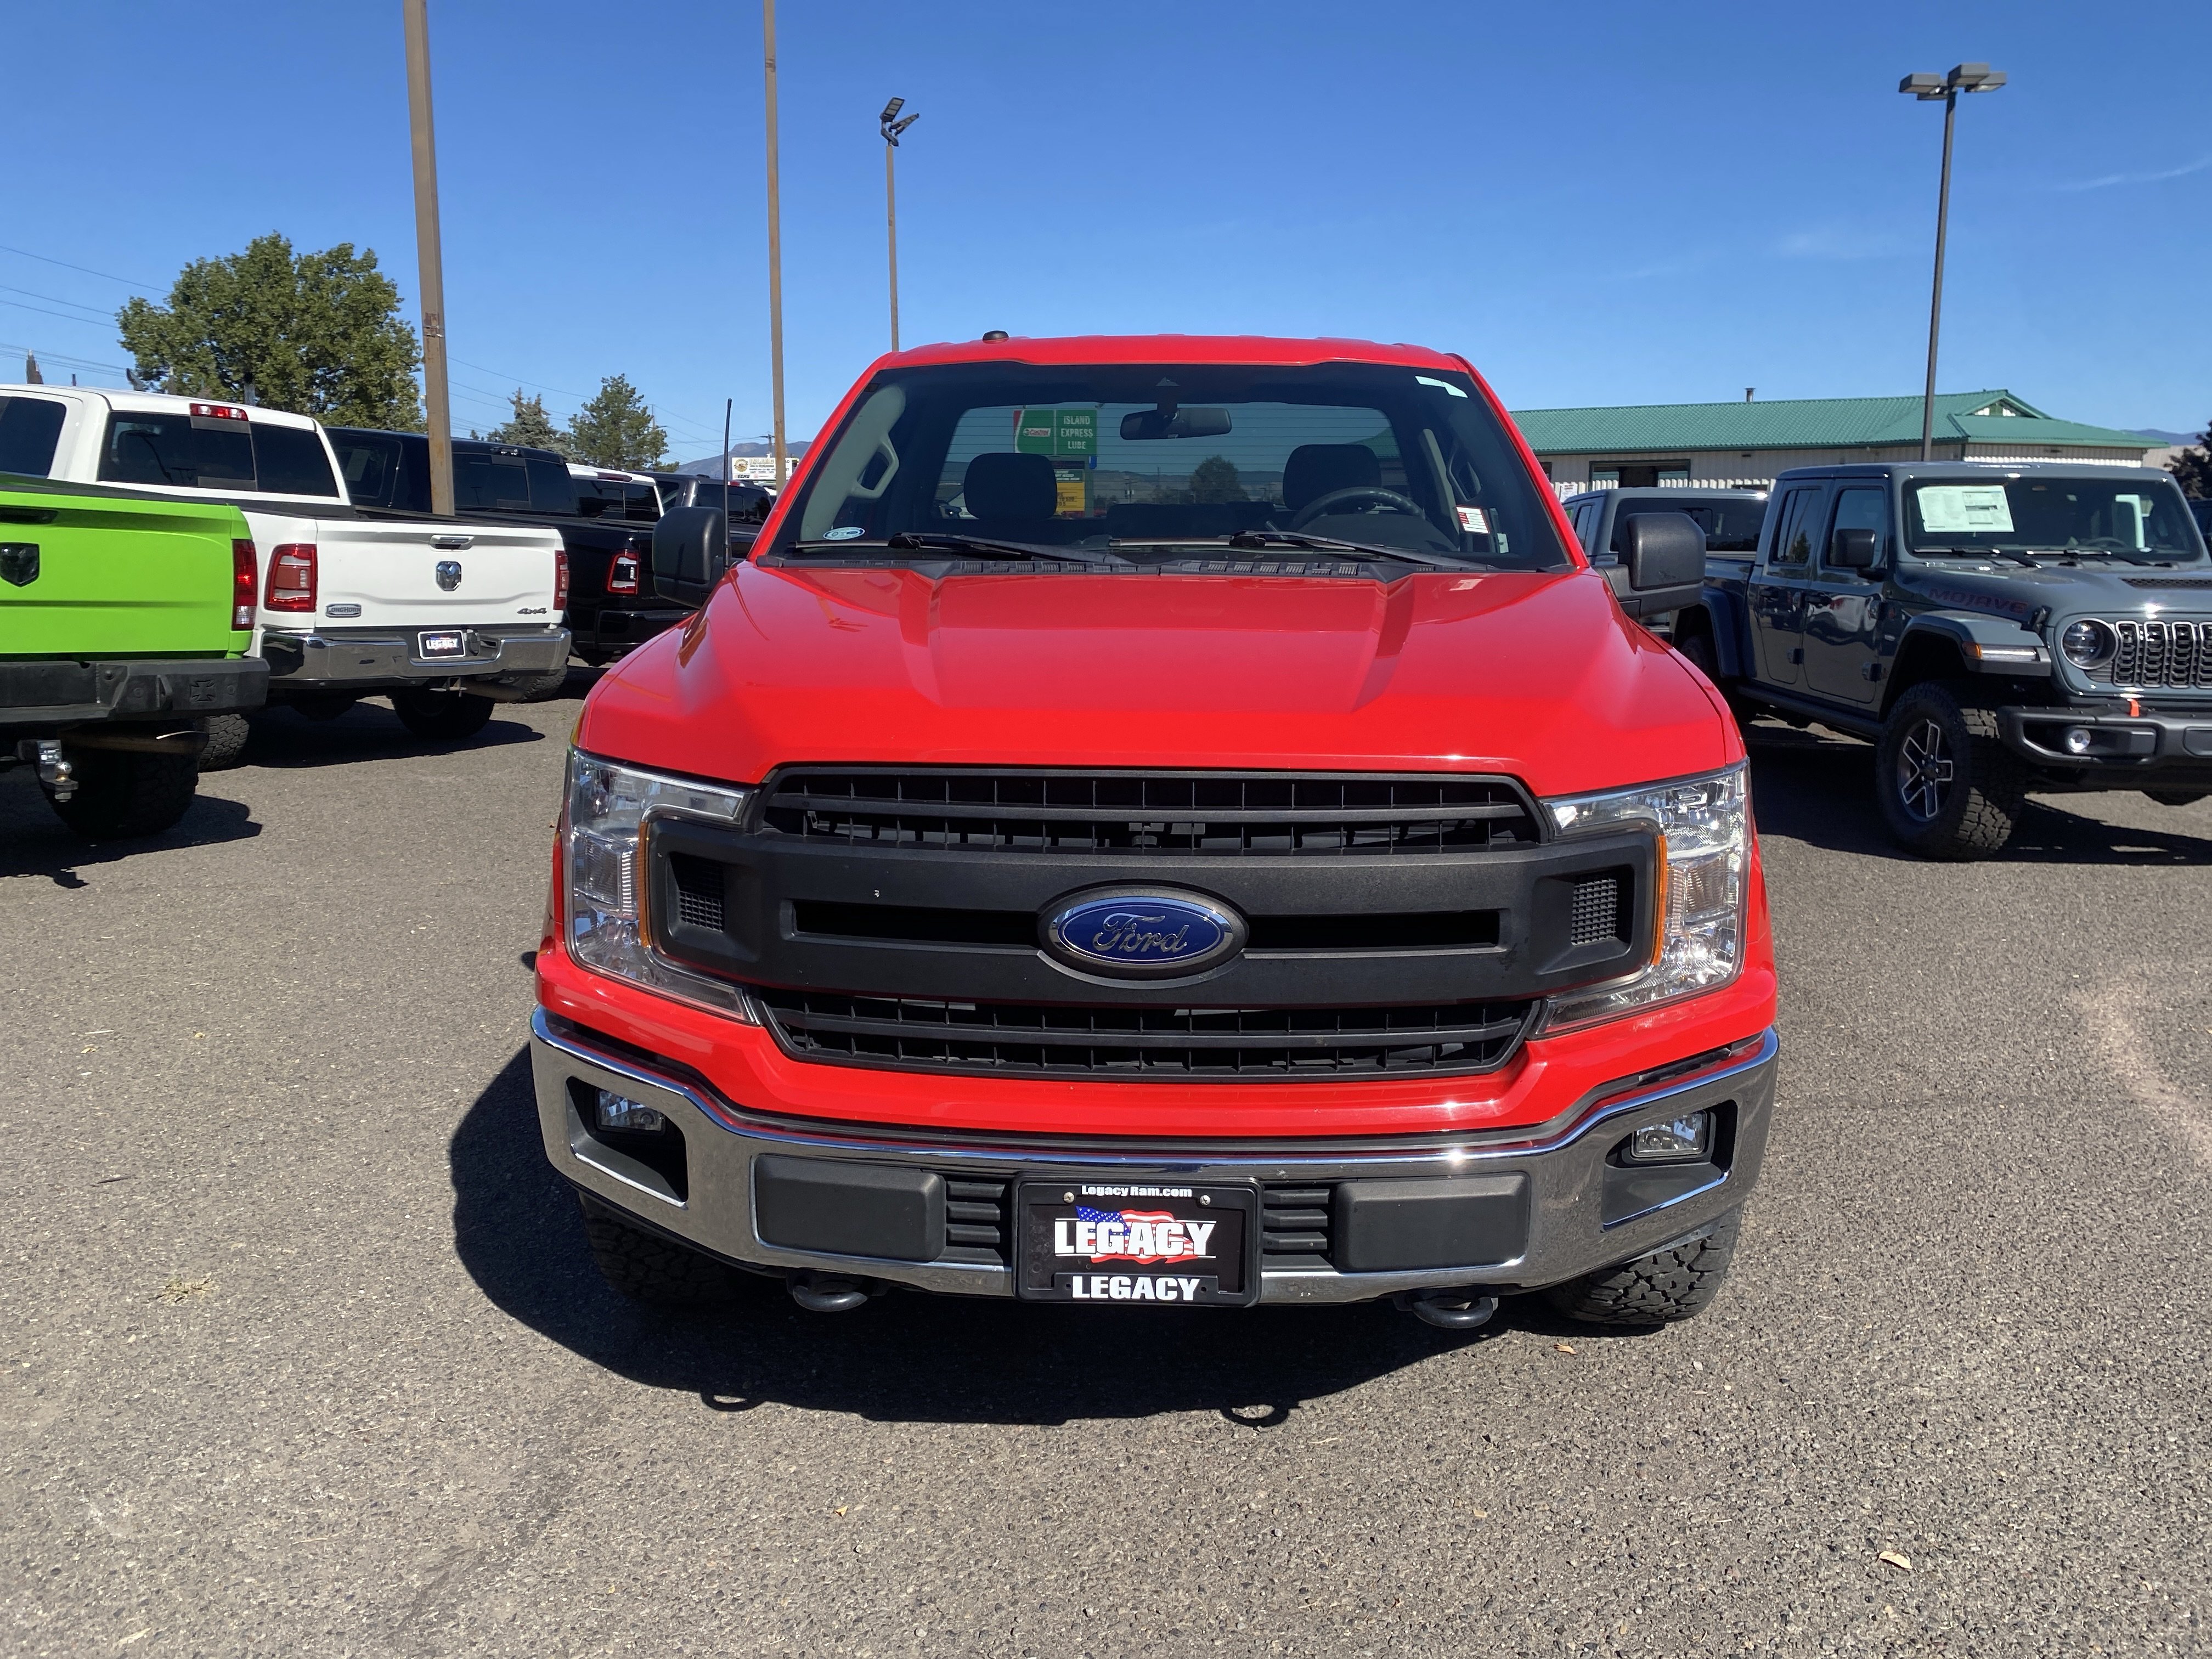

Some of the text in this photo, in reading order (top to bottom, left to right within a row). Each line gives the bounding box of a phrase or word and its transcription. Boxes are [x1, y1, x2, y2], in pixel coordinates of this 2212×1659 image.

[1063, 415, 1090, 425] ISLAND
[1060, 428, 1093, 438] EXPRESS
[1068, 441, 1086, 449] LUBE
[1928, 588, 2028, 614] MOJAVE
[426, 639, 458, 650] LEGACY
[1092, 912, 1190, 953] Ford
[1054, 1221, 1216, 1256] LEGACY
[1072, 1276, 1200, 1301] LEGACY
